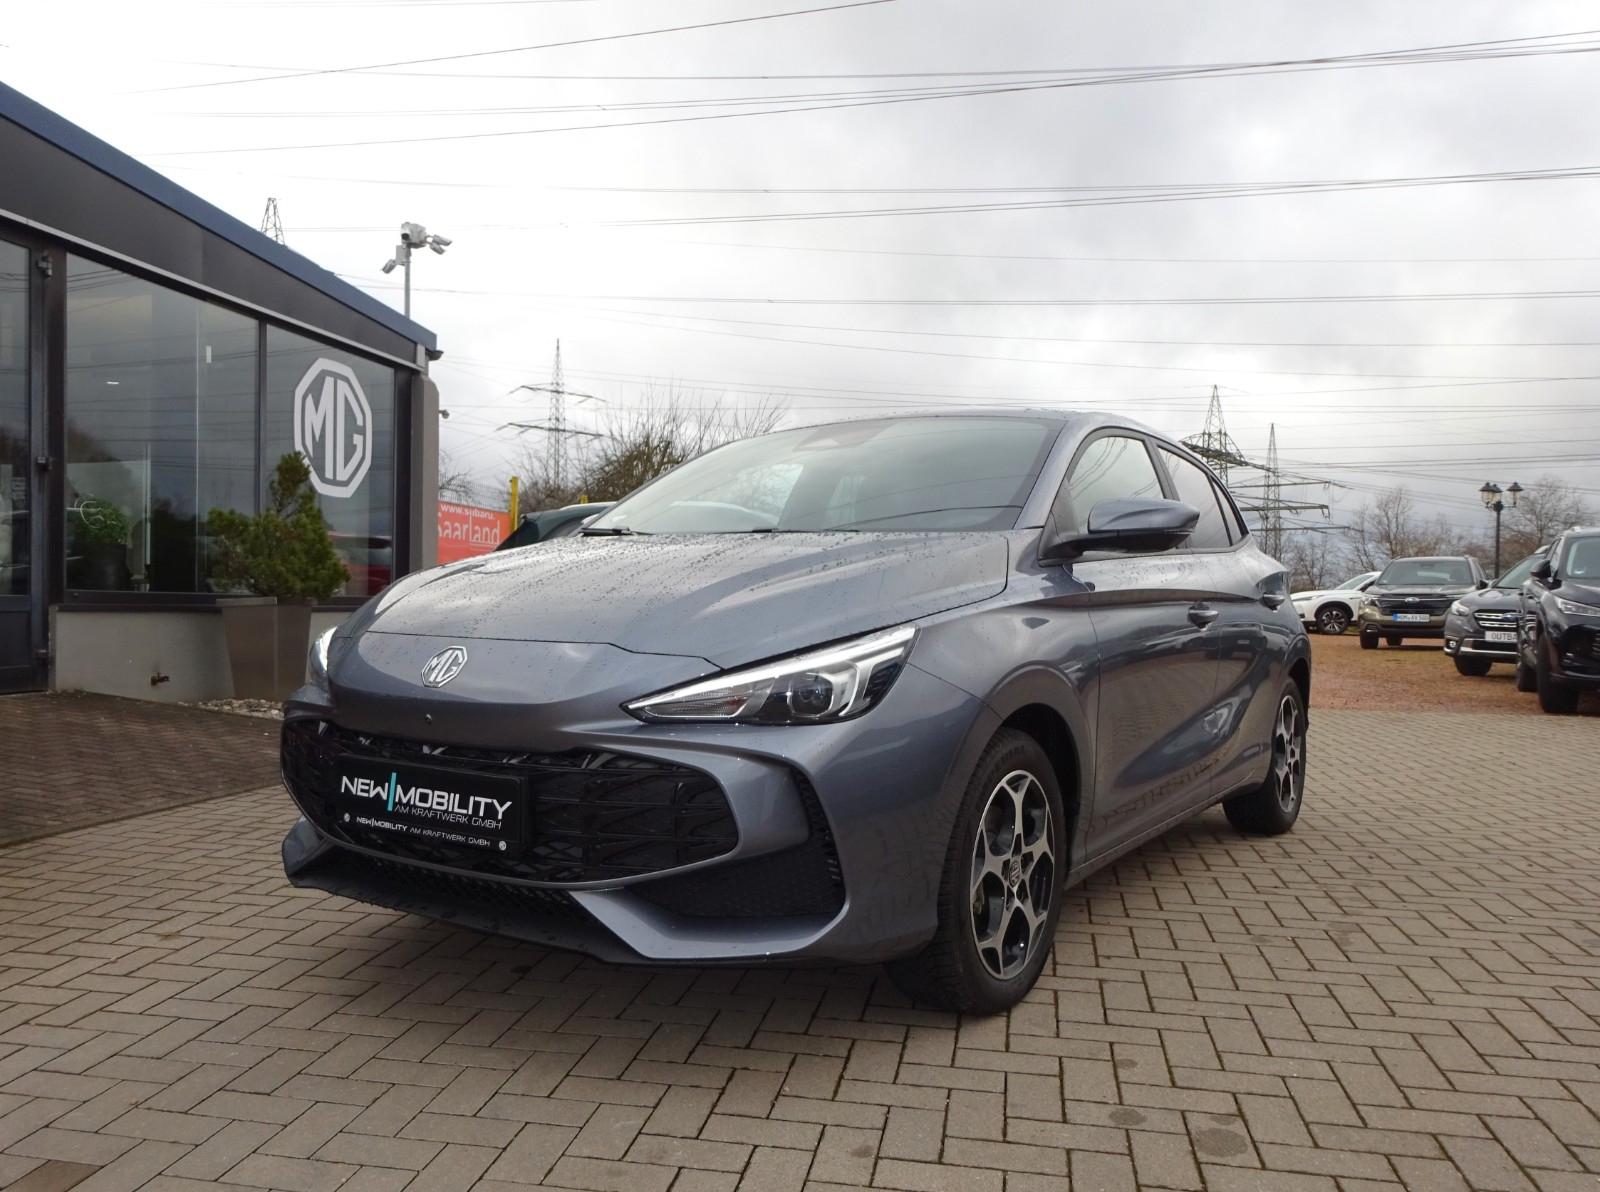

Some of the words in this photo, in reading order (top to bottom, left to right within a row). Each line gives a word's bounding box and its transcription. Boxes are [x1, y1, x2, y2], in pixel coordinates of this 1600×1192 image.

[303, 373, 365, 483] MG
[423, 648, 465, 684] MG
[340, 775, 389, 801] NEW
[395, 784, 513, 820] MOBILITY
[394, 805, 410, 814] AM
[411, 807, 469, 824] KRAFTWERK
[471, 817, 502, 830] GMBH
[422, 829, 467, 843] KRAFTWERK
[468, 836, 491, 847] GMBH
